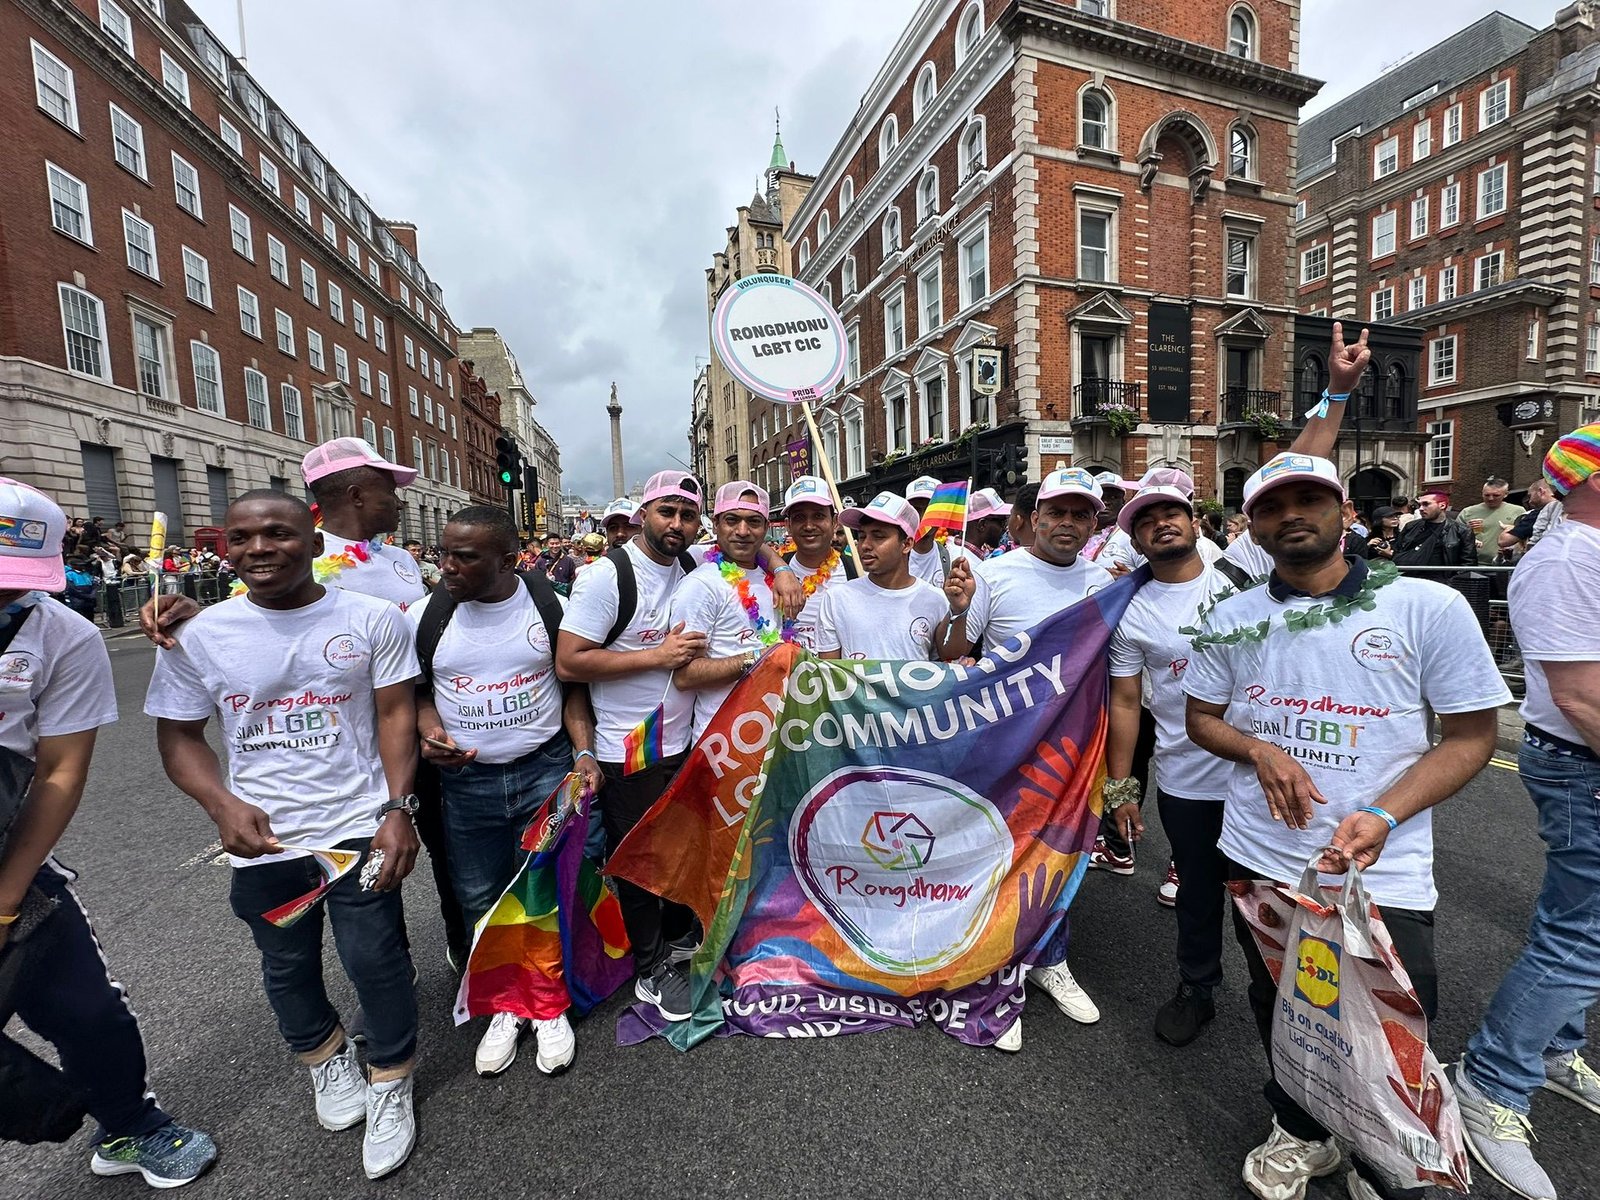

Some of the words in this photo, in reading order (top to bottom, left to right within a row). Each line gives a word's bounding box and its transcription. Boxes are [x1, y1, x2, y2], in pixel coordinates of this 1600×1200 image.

[917, 212, 959, 258] CLARENCE
[737, 276, 791, 290] VOLUNQUEER
[729, 318, 829, 341] RONGDHONU
[1161, 334, 1175, 343] THE
[752, 340, 793, 357] LGBT
[794, 337, 821, 351] CIC
[1149, 343, 1185, 354] CLARENCE
[792, 387, 815, 397] PRIDE
[921, 451, 957, 467] CLARENCE
[450, 669, 550, 694] Rongdhanu
[224, 690, 353, 713] Rongdhanu
[780, 653, 1066, 752] COMMUNITY
[1244, 685, 1391, 718] Rongdhanu
[236, 723, 264, 739] SIAN
[266, 710, 339, 735] LGBT
[460, 707, 540, 730] COMMUNITY
[1283, 716, 1365, 748] LGBT
[825, 866, 973, 907] Rongdhanu
[1282, 997, 1295, 1022] Big
[1298, 1013, 1312, 1030] on
